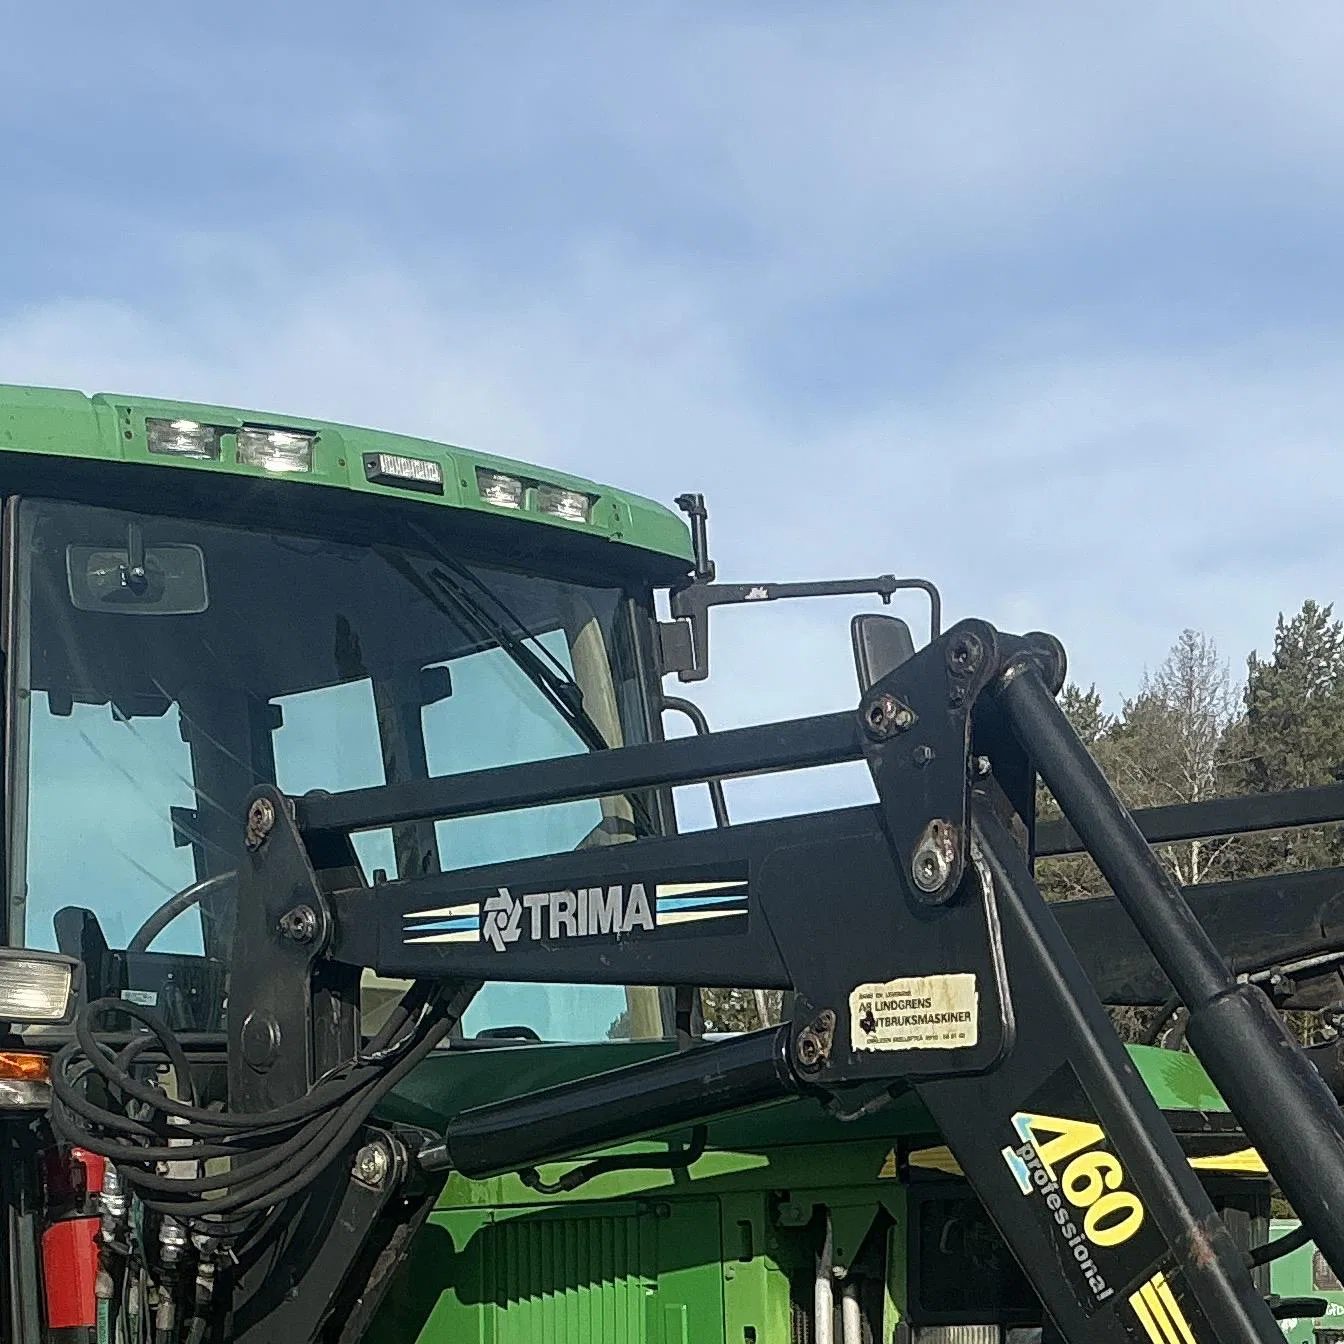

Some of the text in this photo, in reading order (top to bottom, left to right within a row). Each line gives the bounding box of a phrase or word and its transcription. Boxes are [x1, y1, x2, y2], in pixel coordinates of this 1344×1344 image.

[523, 883, 654, 940] TRIMA
[861, 1011, 971, 1028] NTBRUKSMASKINER
[875, 998, 931, 1012] LINDGRENS
[1002, 1111, 1145, 1247] 460
[1016, 1141, 1115, 1302] professional
